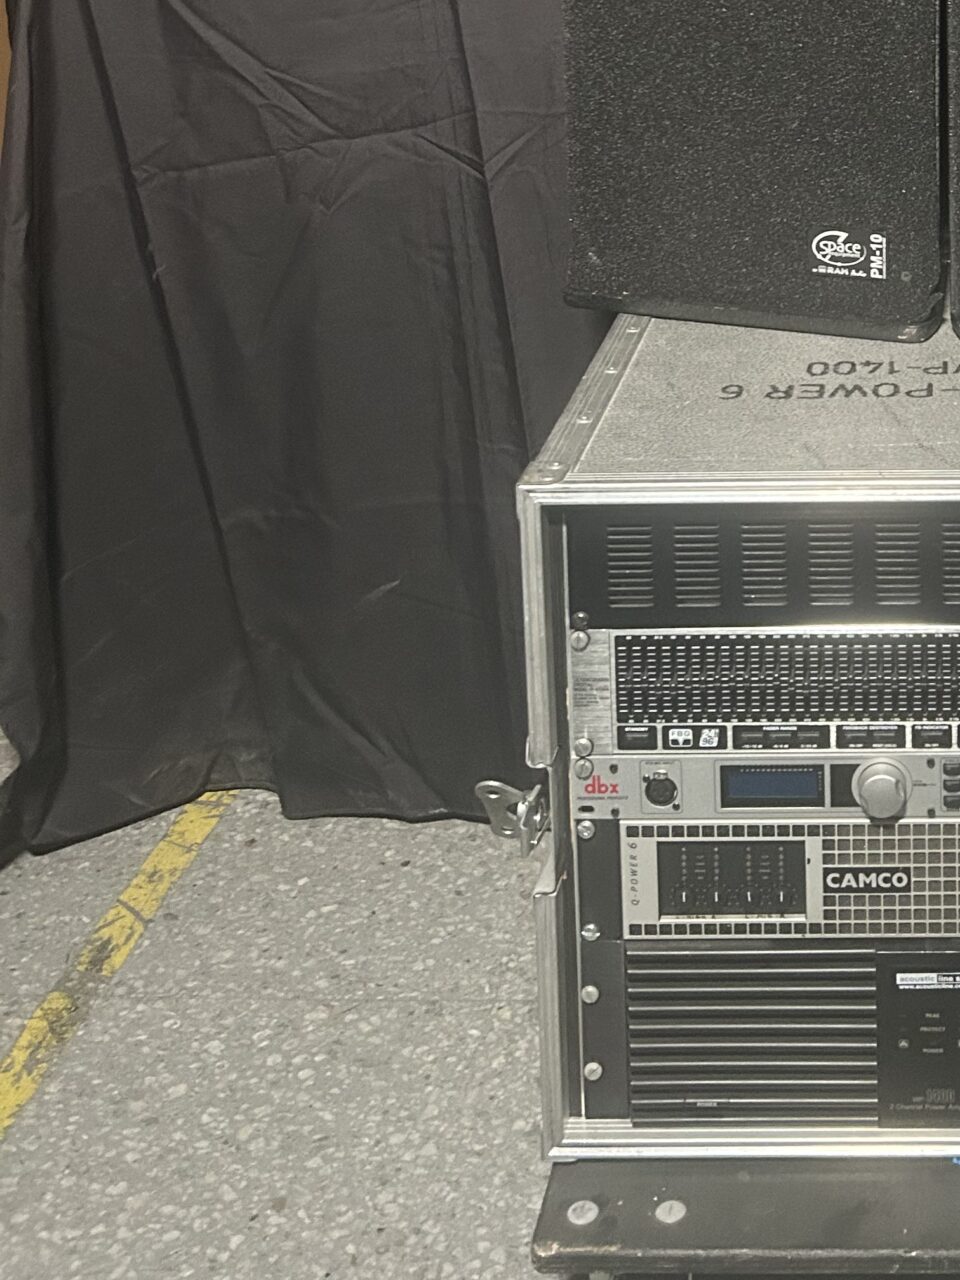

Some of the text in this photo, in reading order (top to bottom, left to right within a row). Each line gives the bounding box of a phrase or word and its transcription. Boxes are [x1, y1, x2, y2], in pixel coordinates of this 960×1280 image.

[819, 240, 861, 255] Space
[869, 233, 883, 279] PM-10
[718, 383, 744, 400] 6
[584, 775, 619, 794] dbx
[627, 842, 641, 906] Q-POWER 6
[825, 872, 909, 889] CAMCO
[899, 975, 936, 983] acoustic
